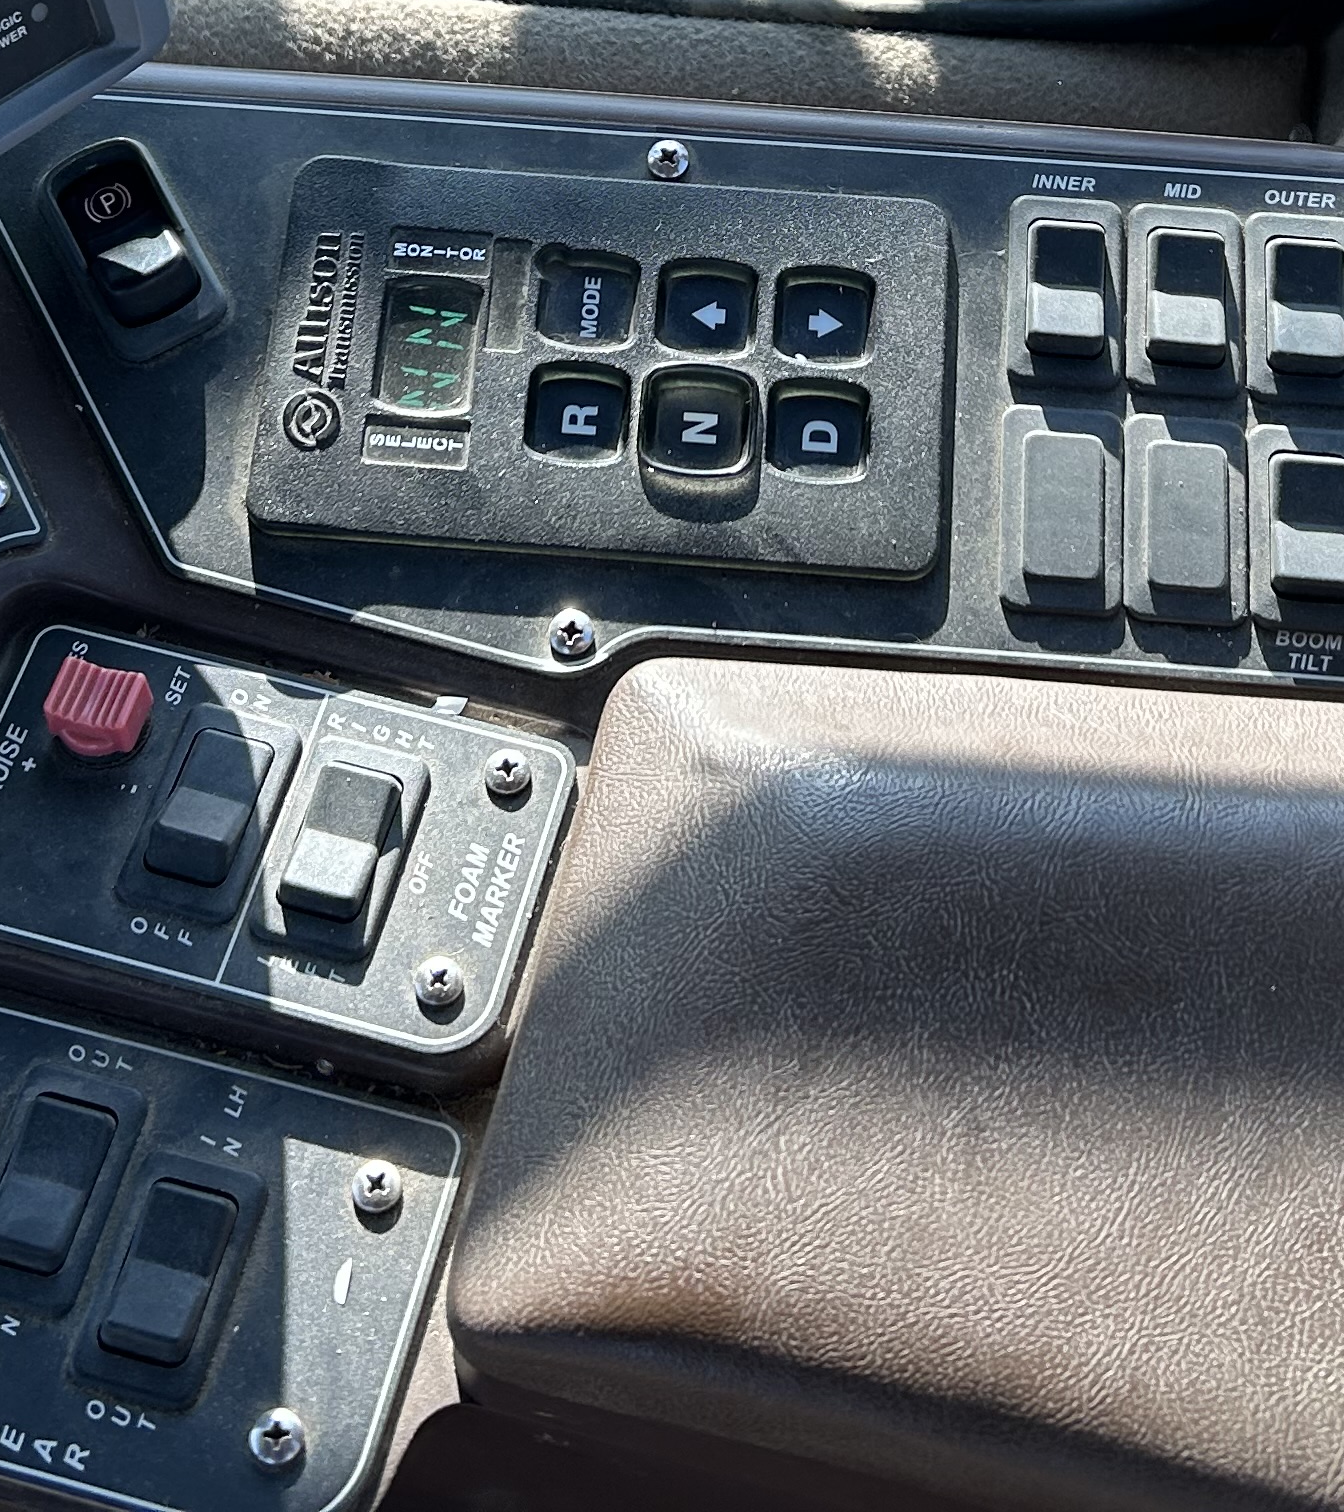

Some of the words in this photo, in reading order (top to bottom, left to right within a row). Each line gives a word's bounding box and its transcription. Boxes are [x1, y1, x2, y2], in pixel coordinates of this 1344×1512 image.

[1032, 173, 1095, 192] INNER
[1164, 183, 1201, 200] MID
[1264, 190, 1336, 209] OUTER
[393, 242, 486, 260] MONITOR
[293, 232, 342, 388] Allison
[328, 232, 365, 390] Transmission
[580, 276, 601, 338] MODE
[561, 404, 599, 435] R
[681, 412, 718, 444] N
[370, 433, 464, 451] SELECT
[801, 420, 838, 454] D
[1275, 630, 1342, 650] BOOM
[1288, 653, 1333, 672] TILT
[165, 665, 192, 705] SET
[231, 688, 272, 712] ON
[328, 713, 435, 751] RIGHT
[408, 852, 433, 895] OFF
[449, 843, 490, 922] FOAM
[471, 832, 526, 948] MARKER
[130, 916, 195, 947] OFF
[68, 1044, 133, 1072] OUT
[224, 1086, 248, 1118] LH
[201, 1134, 243, 1156] IN
[86, 1400, 157, 1430] OUT
